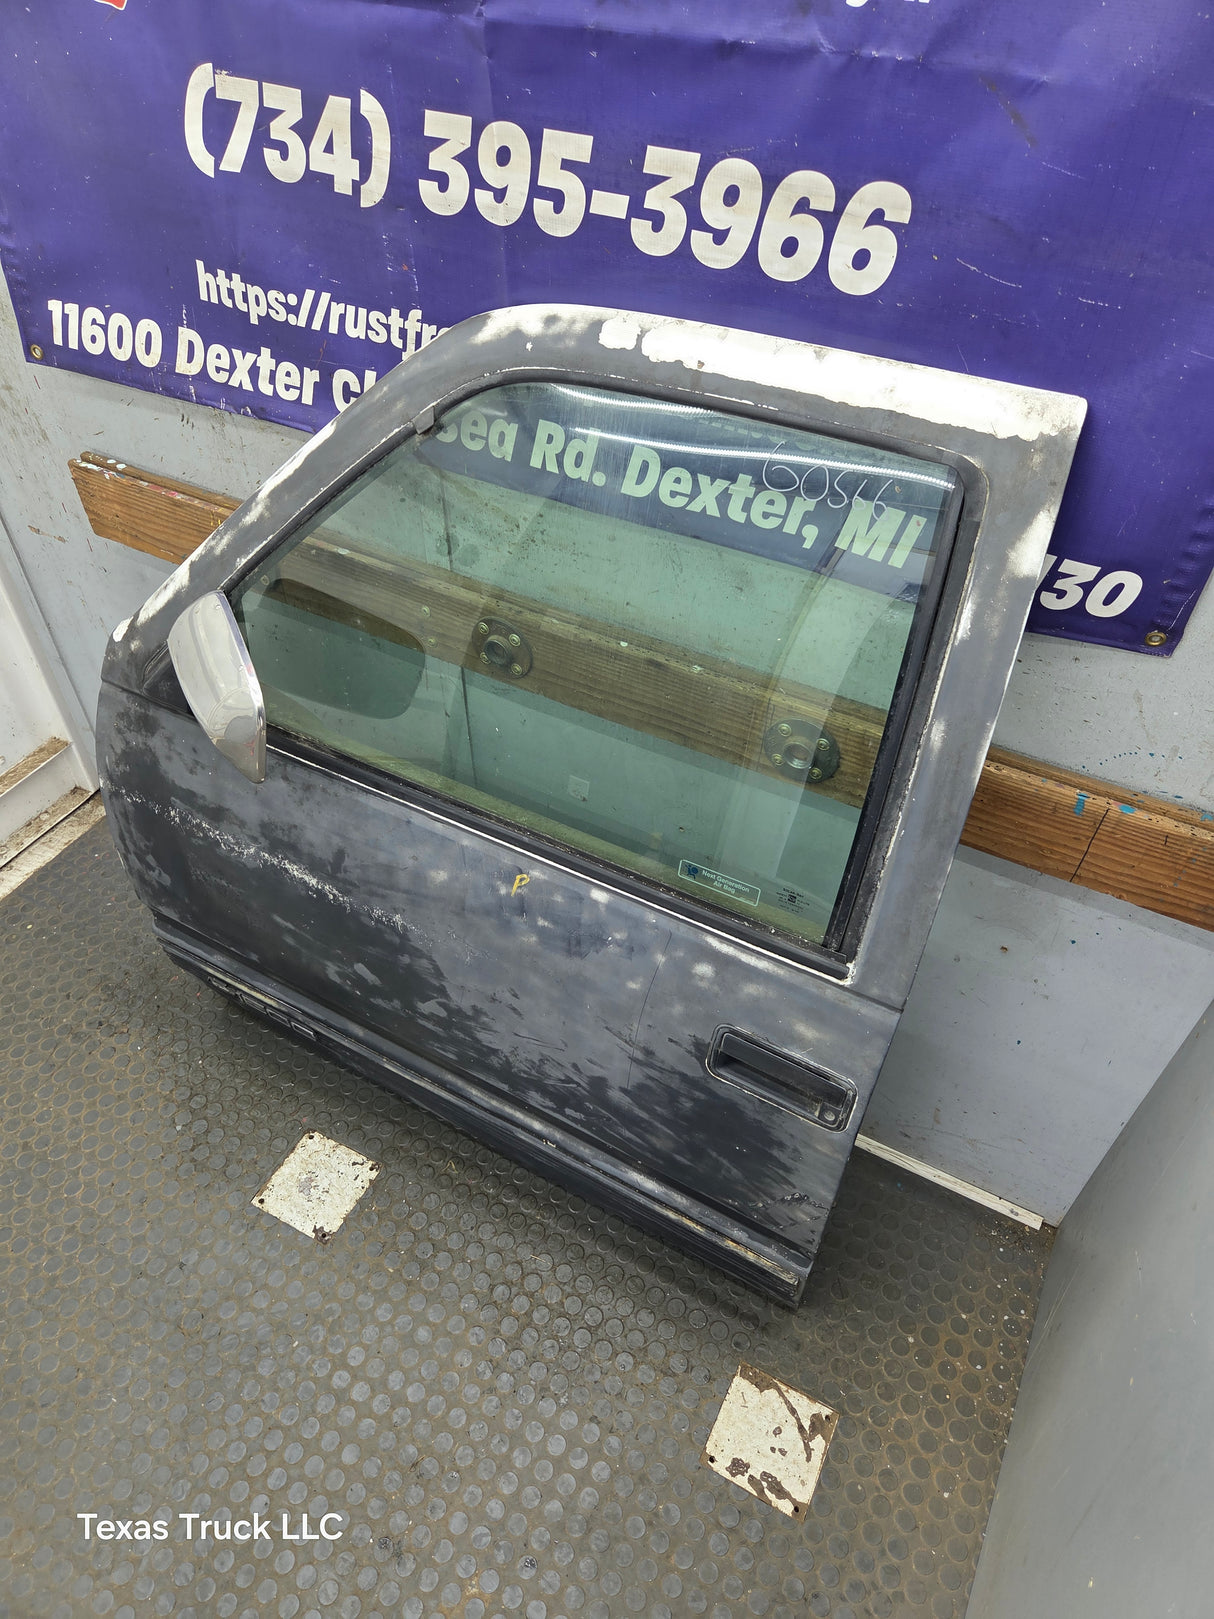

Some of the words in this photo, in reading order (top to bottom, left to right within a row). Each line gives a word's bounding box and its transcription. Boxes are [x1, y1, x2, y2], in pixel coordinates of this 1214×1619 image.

[184, 62, 391, 208] (734)
[418, 109, 912, 296] 395-3966
[195, 259, 452, 361] https://rustfr
[47, 300, 162, 368] 11600
[175, 326, 320, 405] Dexter
[529, 419, 607, 487] Rd.
[620, 445, 819, 549] Dexter,
[834, 500, 927, 568] MI
[511, 873, 530, 897] P
[702, 870, 716, 880] Next
[716, 876, 750, 893] Generation
